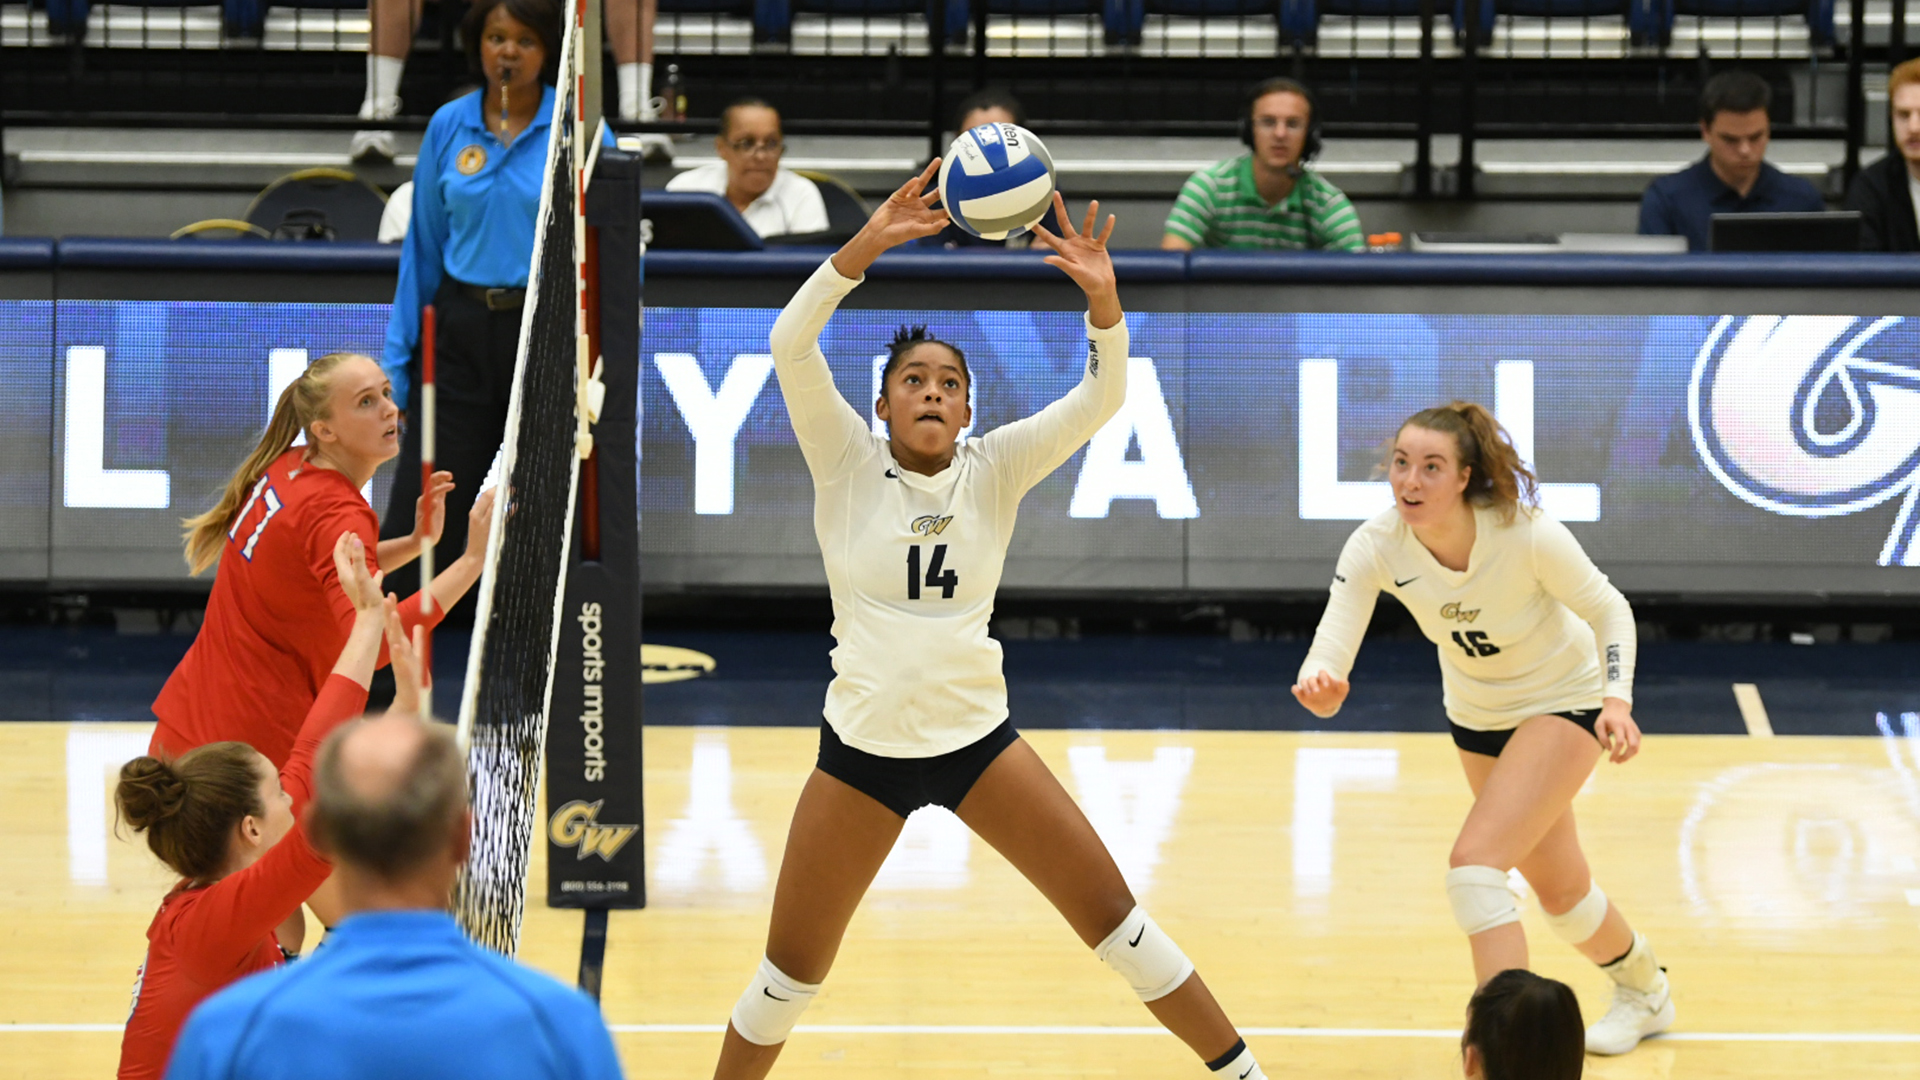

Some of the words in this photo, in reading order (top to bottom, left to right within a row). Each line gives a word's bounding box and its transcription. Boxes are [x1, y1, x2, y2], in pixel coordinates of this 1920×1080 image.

[227, 472, 285, 563] 17
[911, 514, 955, 537] GW
[906, 543, 958, 600] 14
[577, 602, 606, 682] sports
[1440, 601, 1481, 624] GW
[1451, 630, 1501, 658] 16
[579, 684, 608, 782] imports
[547, 798, 640, 863] GW
